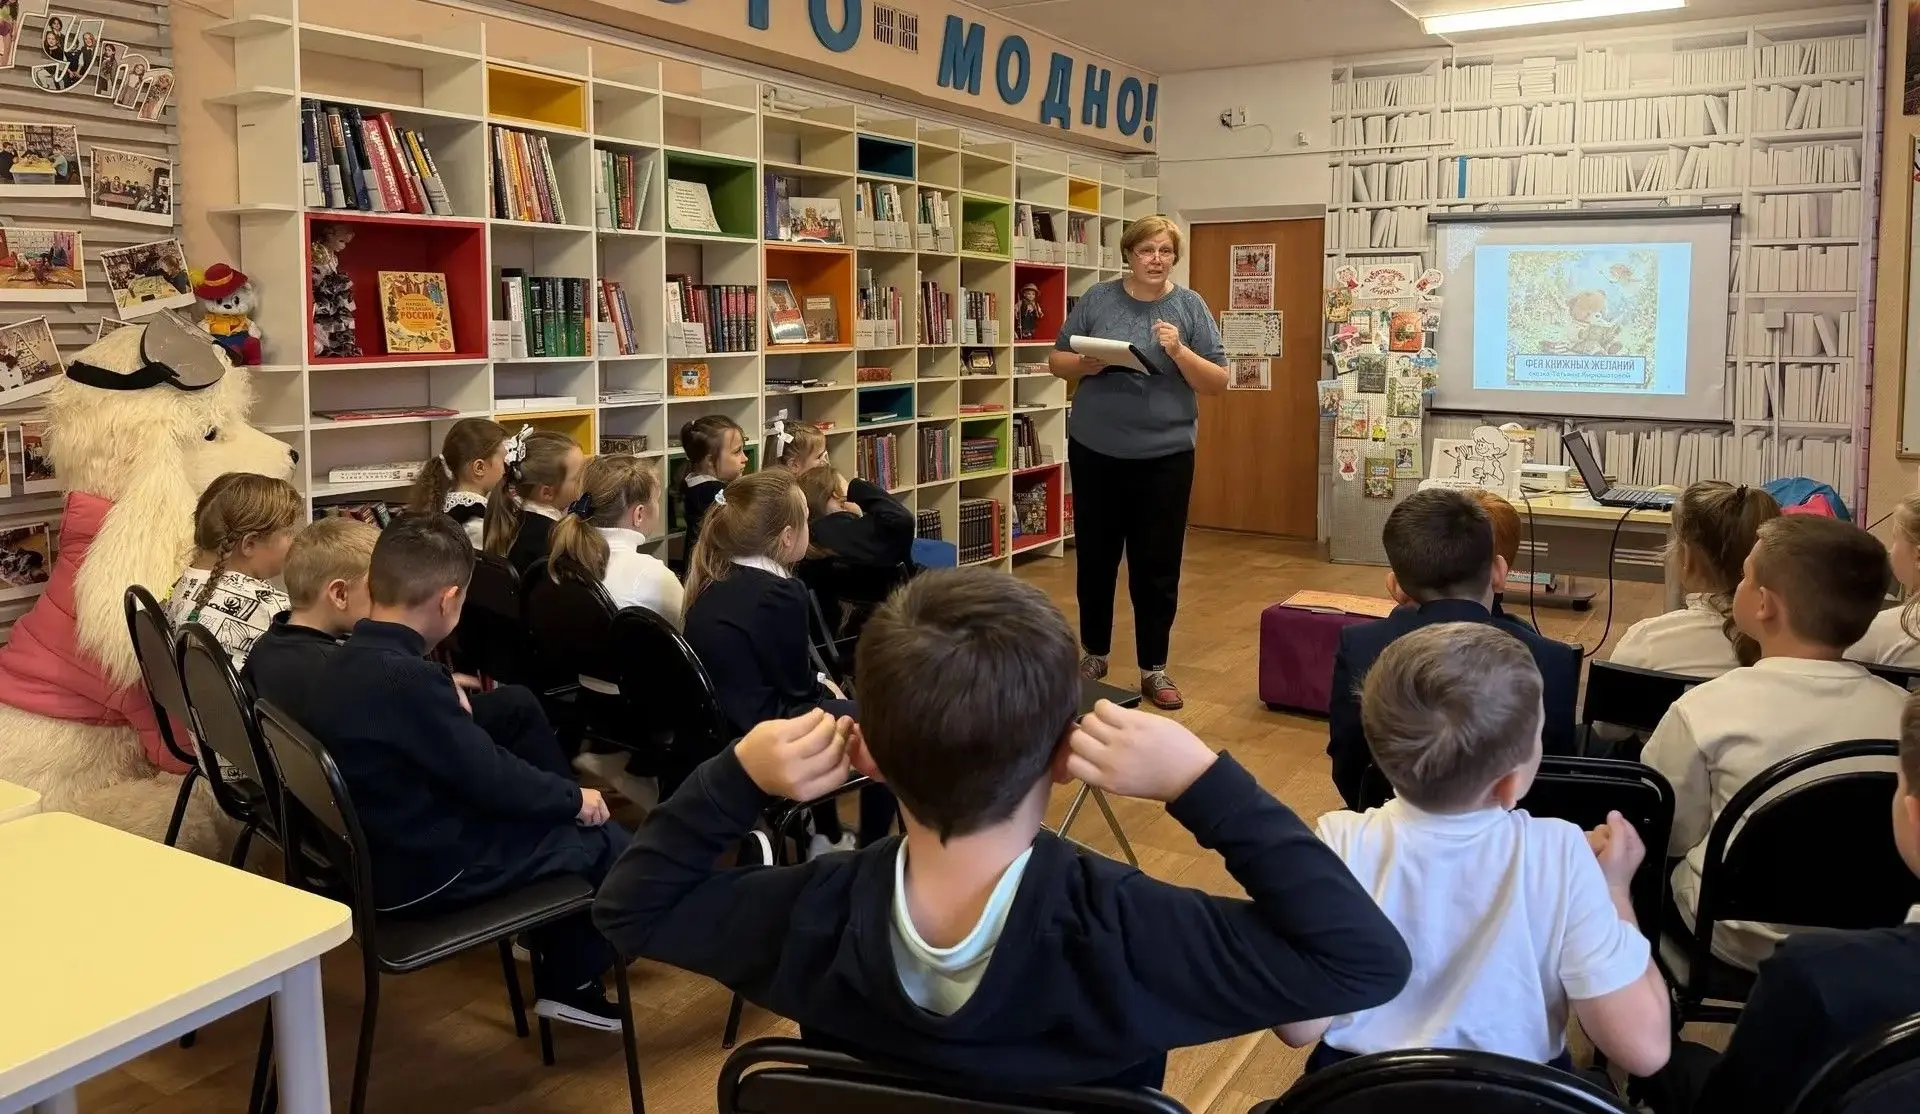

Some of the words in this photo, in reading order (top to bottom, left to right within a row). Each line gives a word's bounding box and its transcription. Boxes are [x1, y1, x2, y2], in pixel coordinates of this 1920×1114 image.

[937, 14, 1158, 143] МОДНО!
[1525, 359, 1544, 369] ФЕЯ
[1545, 359, 1590, 370] КНИЖНЫХ
[1591, 359, 1635, 371] ЖЕЛАНИЙ
